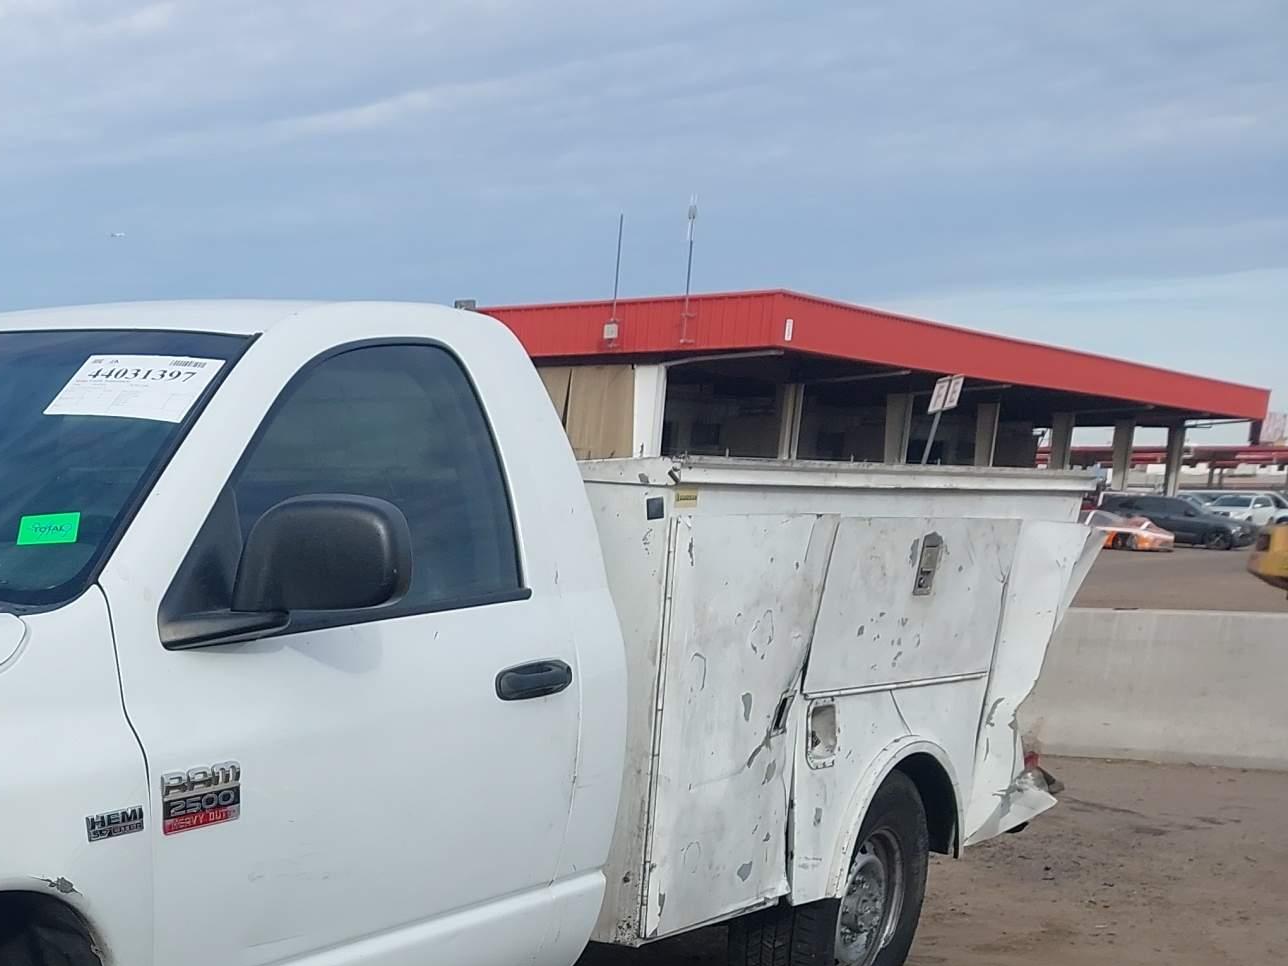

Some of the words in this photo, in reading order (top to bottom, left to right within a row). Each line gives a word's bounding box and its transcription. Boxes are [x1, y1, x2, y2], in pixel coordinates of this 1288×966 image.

[87, 367, 198, 383] 44031397
[161, 761, 241, 796] RAM
[169, 790, 235, 817] 2500
[87, 805, 142, 829] HEMI
[168, 815, 204, 831] HEAVY
